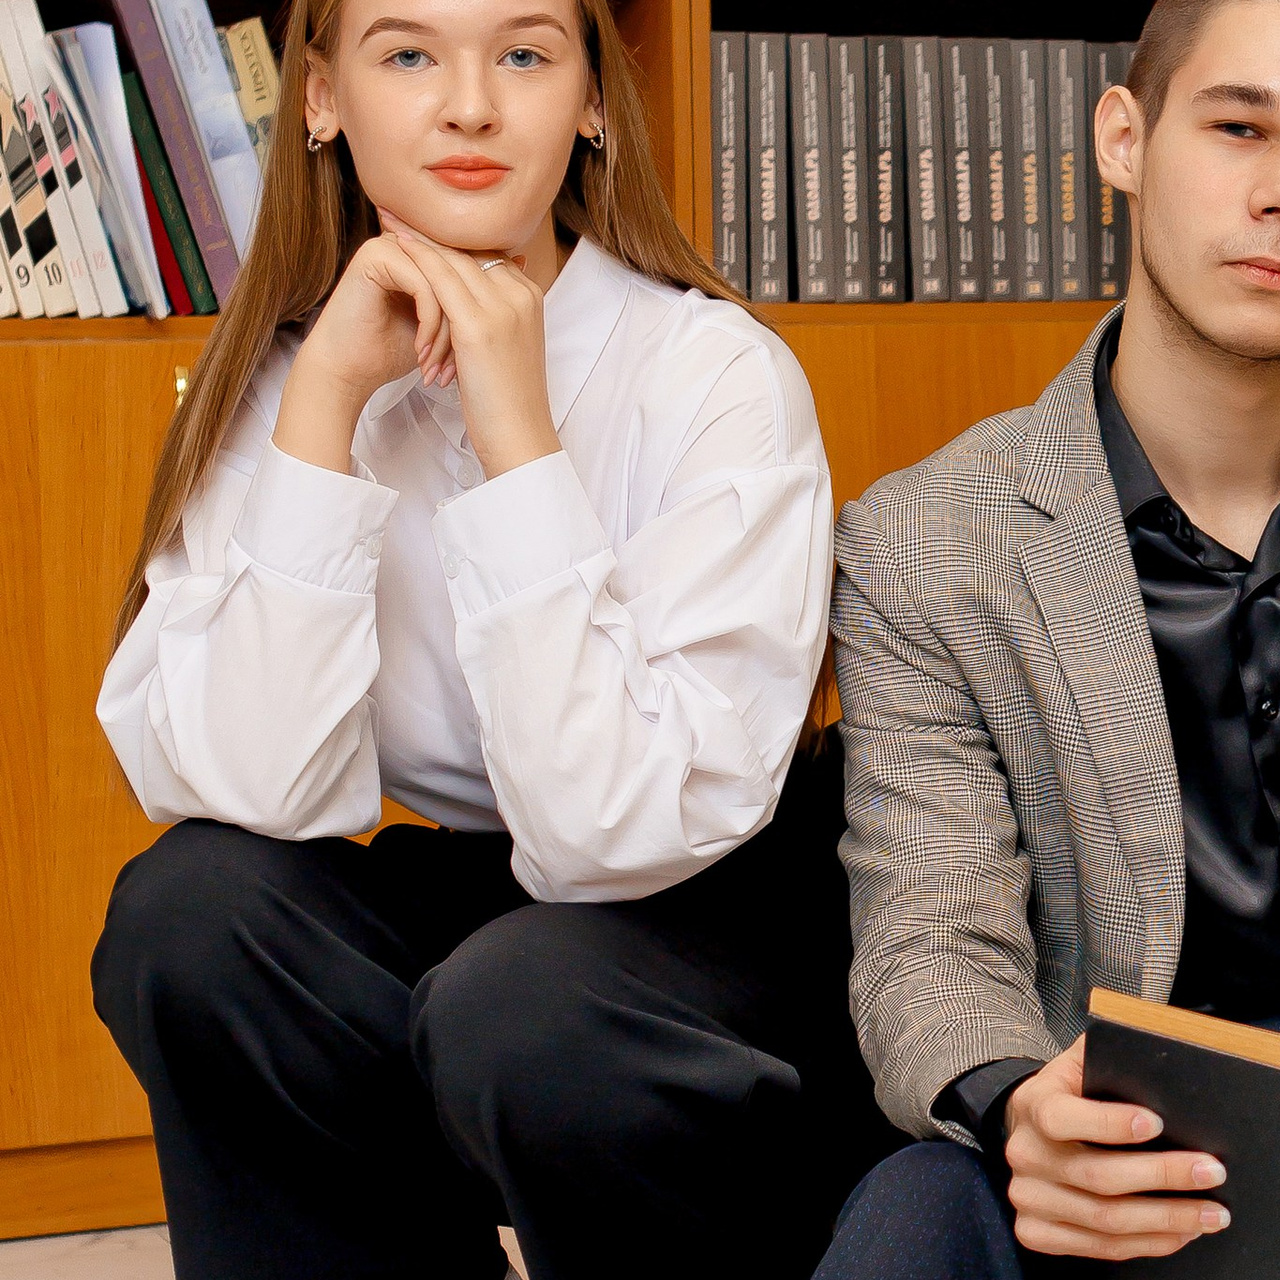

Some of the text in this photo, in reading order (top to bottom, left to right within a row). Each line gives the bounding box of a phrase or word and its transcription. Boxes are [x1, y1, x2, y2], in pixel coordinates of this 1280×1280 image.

[1100, 182, 1114, 226] СЛОВ
[15, 263, 30, 288] 9
[44, 262, 62, 286] 10
[70, 258, 83, 278] 11
